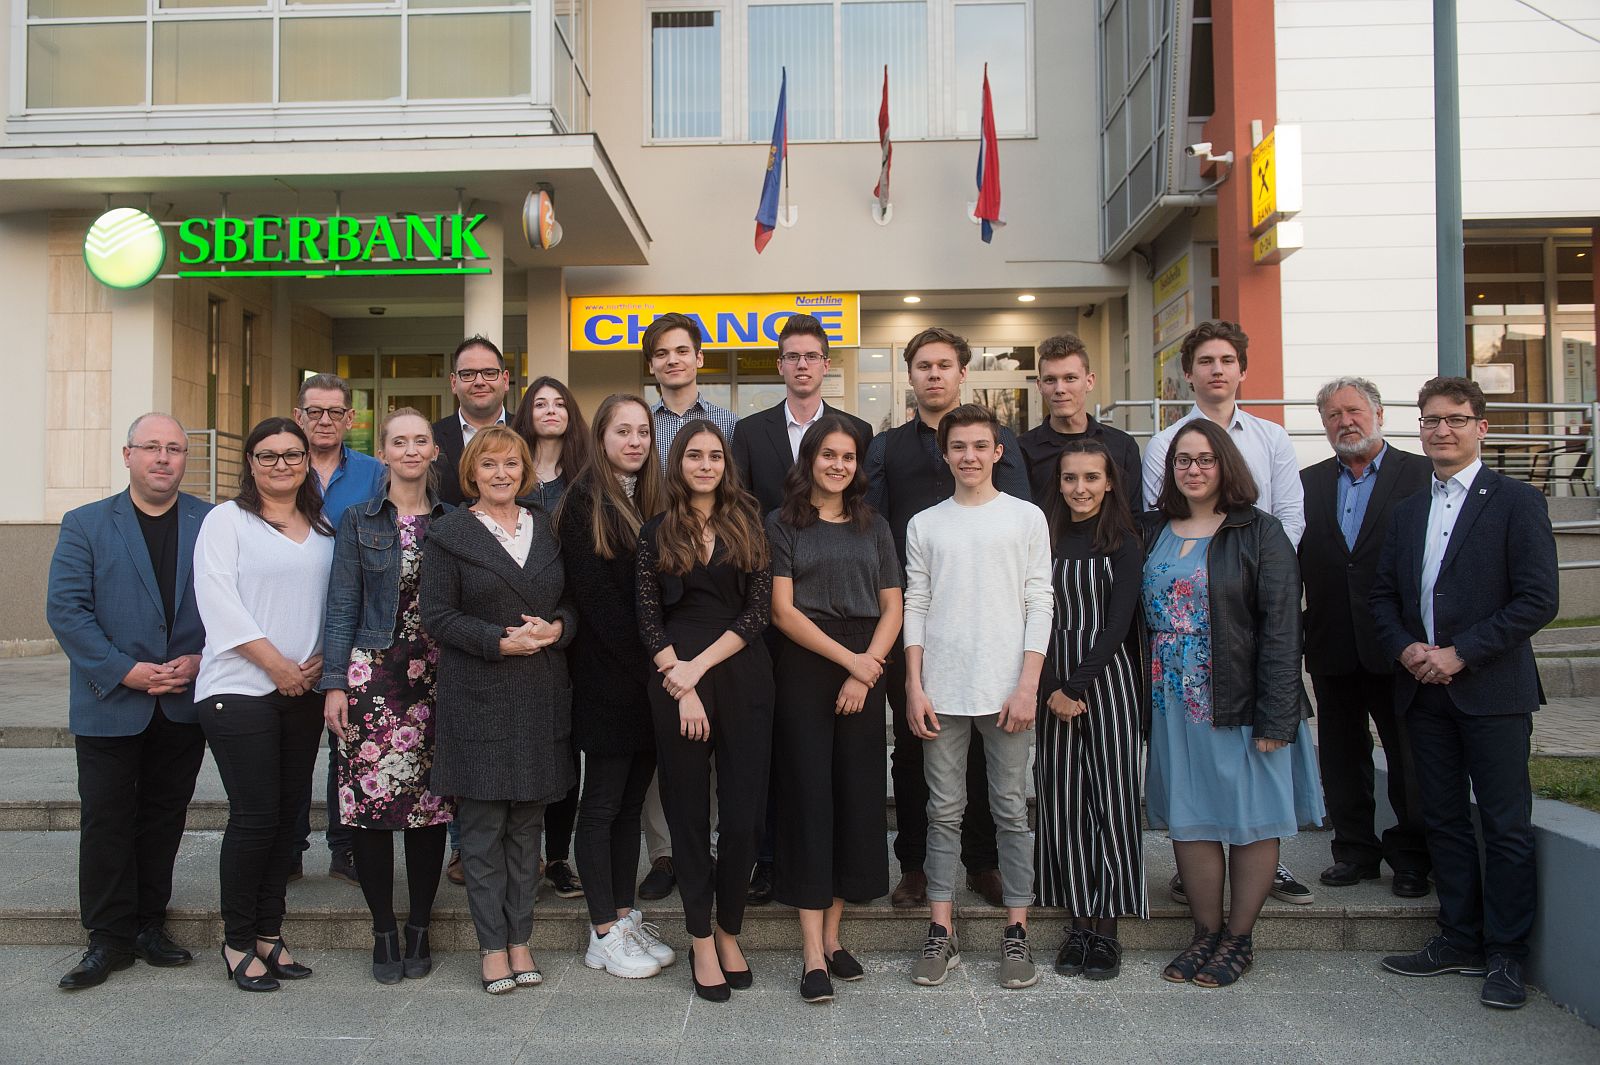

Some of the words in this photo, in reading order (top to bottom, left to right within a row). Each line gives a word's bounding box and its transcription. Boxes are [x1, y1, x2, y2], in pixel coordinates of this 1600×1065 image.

[178, 213, 489, 264] SBERBANK
[796, 295, 843, 306] Northline
[584, 303, 655, 311] www.northline.hu
